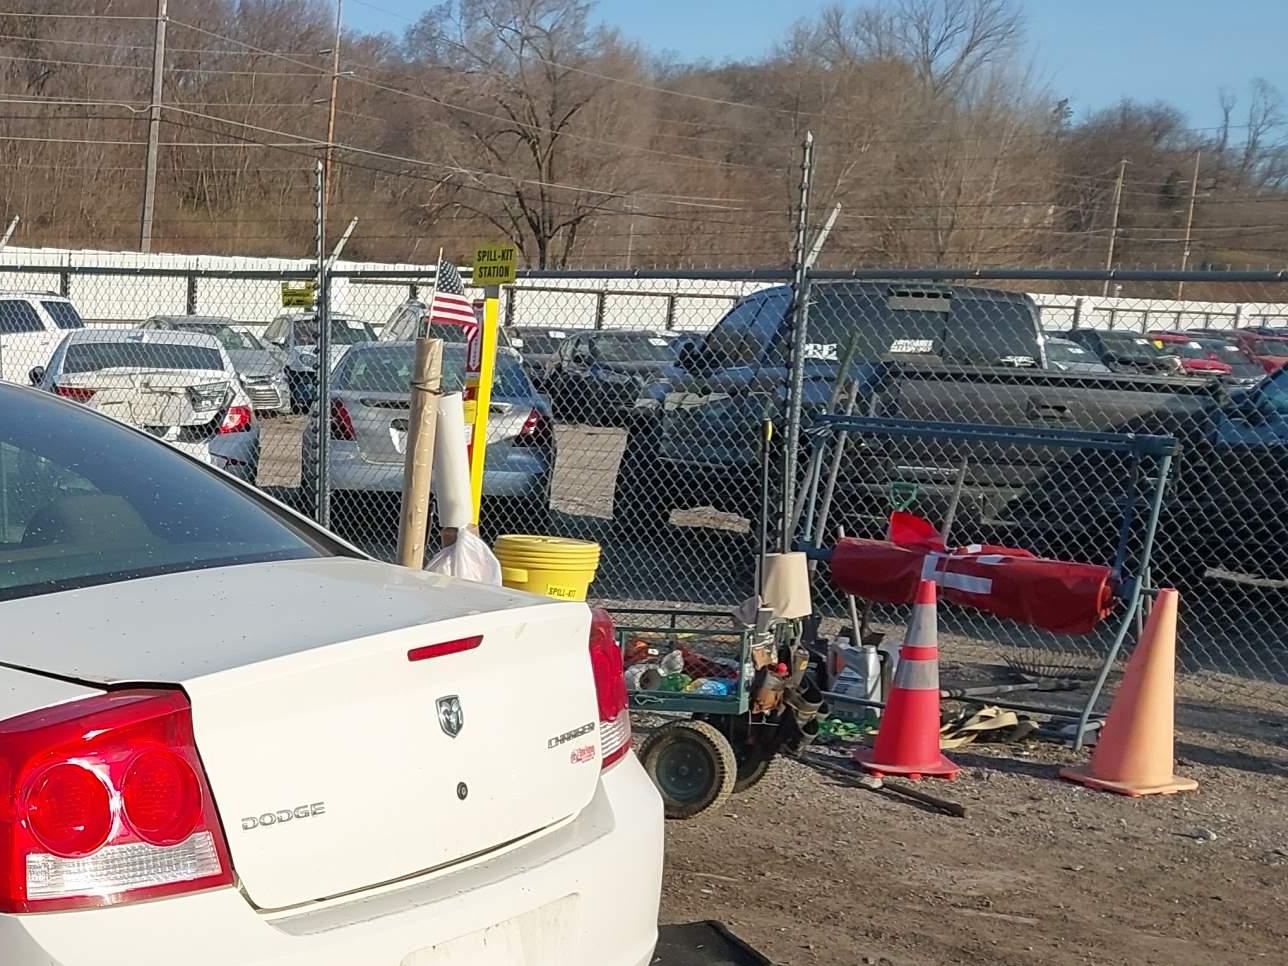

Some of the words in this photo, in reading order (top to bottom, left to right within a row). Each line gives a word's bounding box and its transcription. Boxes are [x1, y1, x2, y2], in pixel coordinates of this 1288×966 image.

[477, 249, 514, 262] SPILL-KIT
[478, 266, 509, 278] STATION
[547, 721, 595, 748] CHARGER
[241, 801, 326, 831] DODGE
